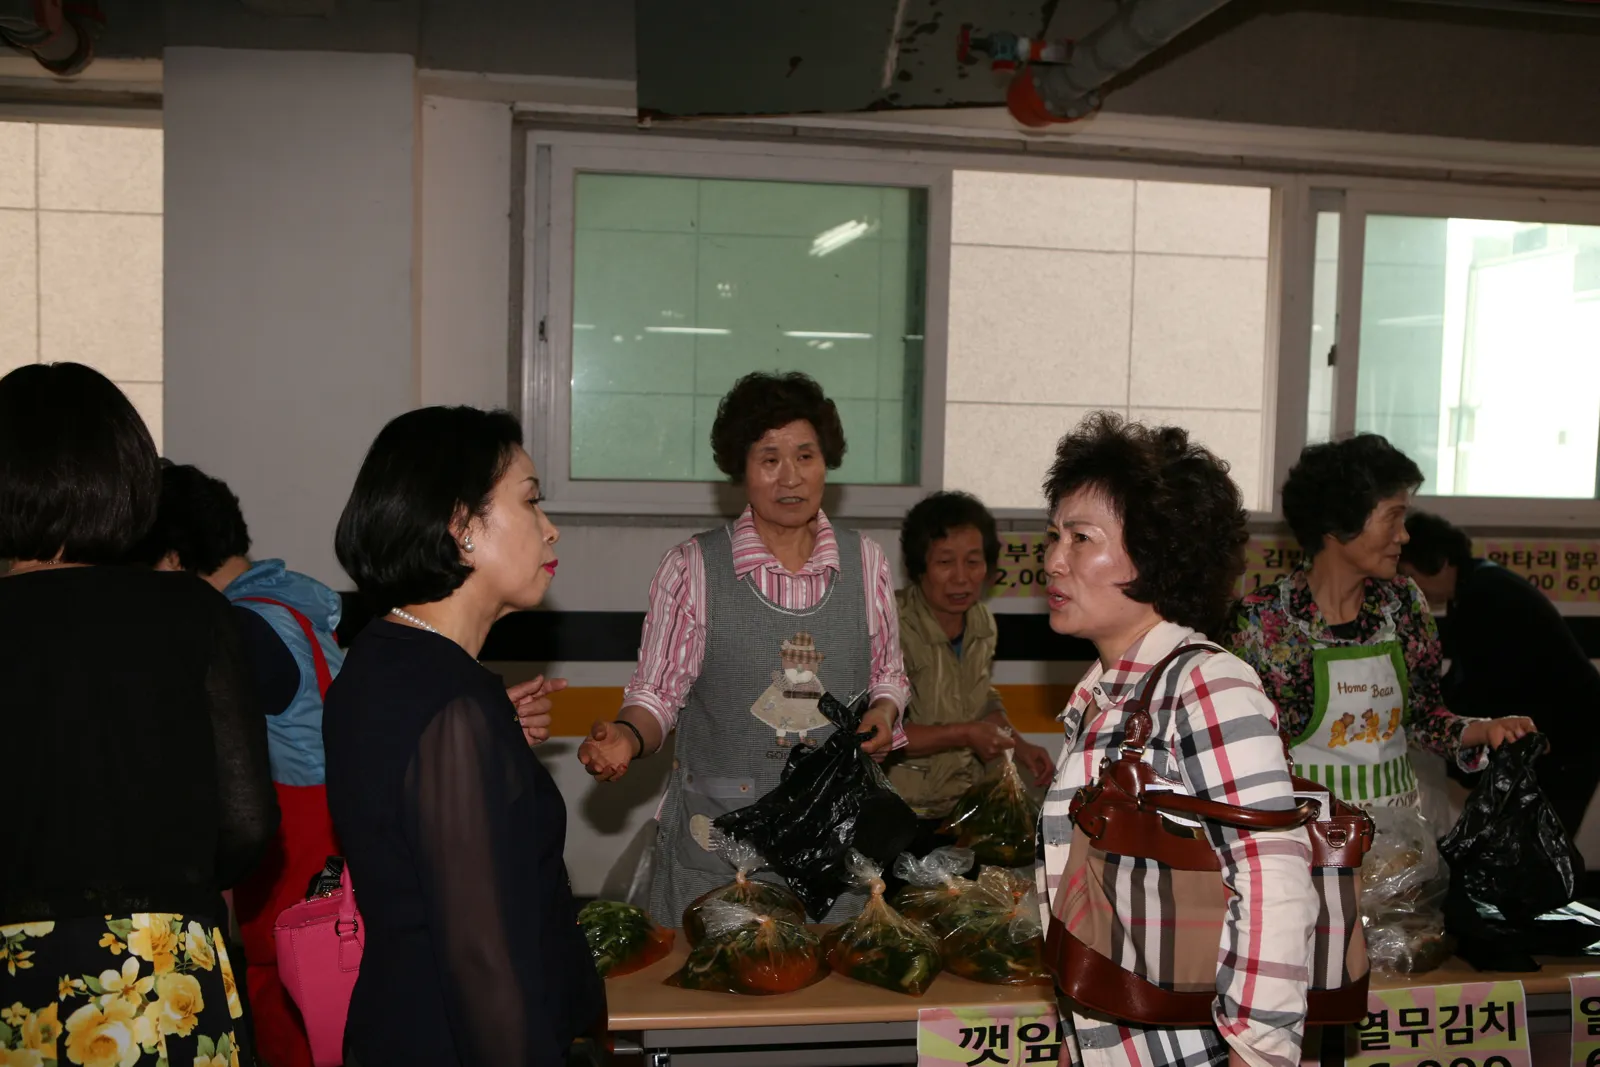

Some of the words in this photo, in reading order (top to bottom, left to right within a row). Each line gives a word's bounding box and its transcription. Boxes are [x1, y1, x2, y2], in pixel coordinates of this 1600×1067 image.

[1337, 681, 1368, 695] Home
[1371, 683, 1395, 698] Bear
[958, 1022, 1062, 1067] 깻잎
[1354, 1001, 1517, 1051] 열무김치
